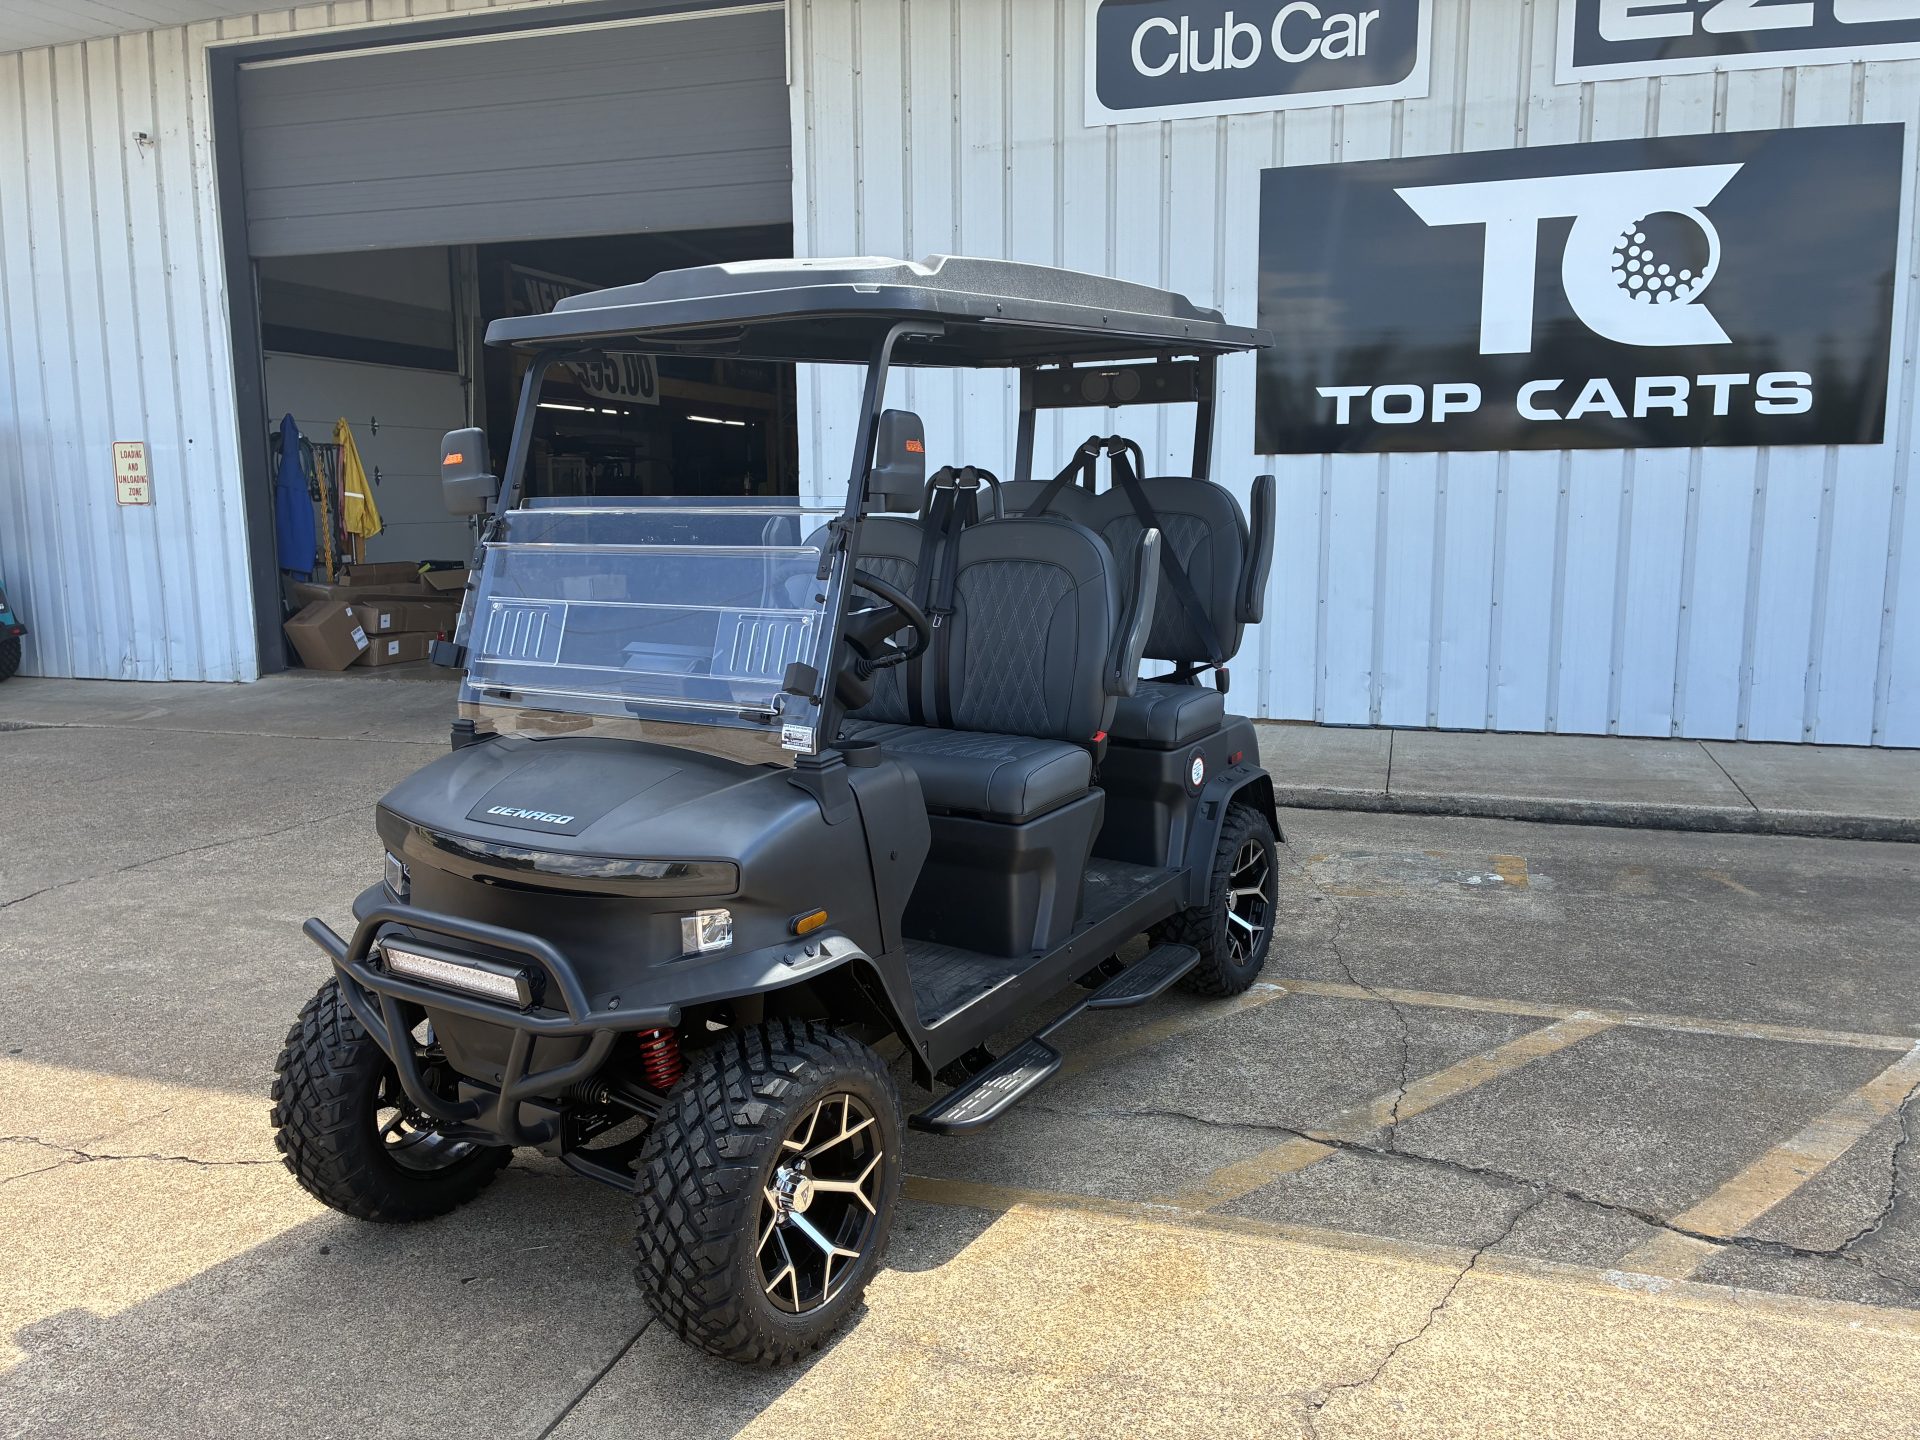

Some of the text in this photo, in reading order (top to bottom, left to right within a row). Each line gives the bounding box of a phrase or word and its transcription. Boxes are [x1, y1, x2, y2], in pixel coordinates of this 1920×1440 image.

[1131, 1, 1380, 77] Club Car
[1316, 371, 1813, 425] TOP CARTS
[120, 450, 143, 459] LOADING
[127, 462, 139, 471] AND
[118, 475, 147, 484] UNLOADING
[128, 487, 142, 496] ZONE
[486, 805, 576, 825] DENAGO
